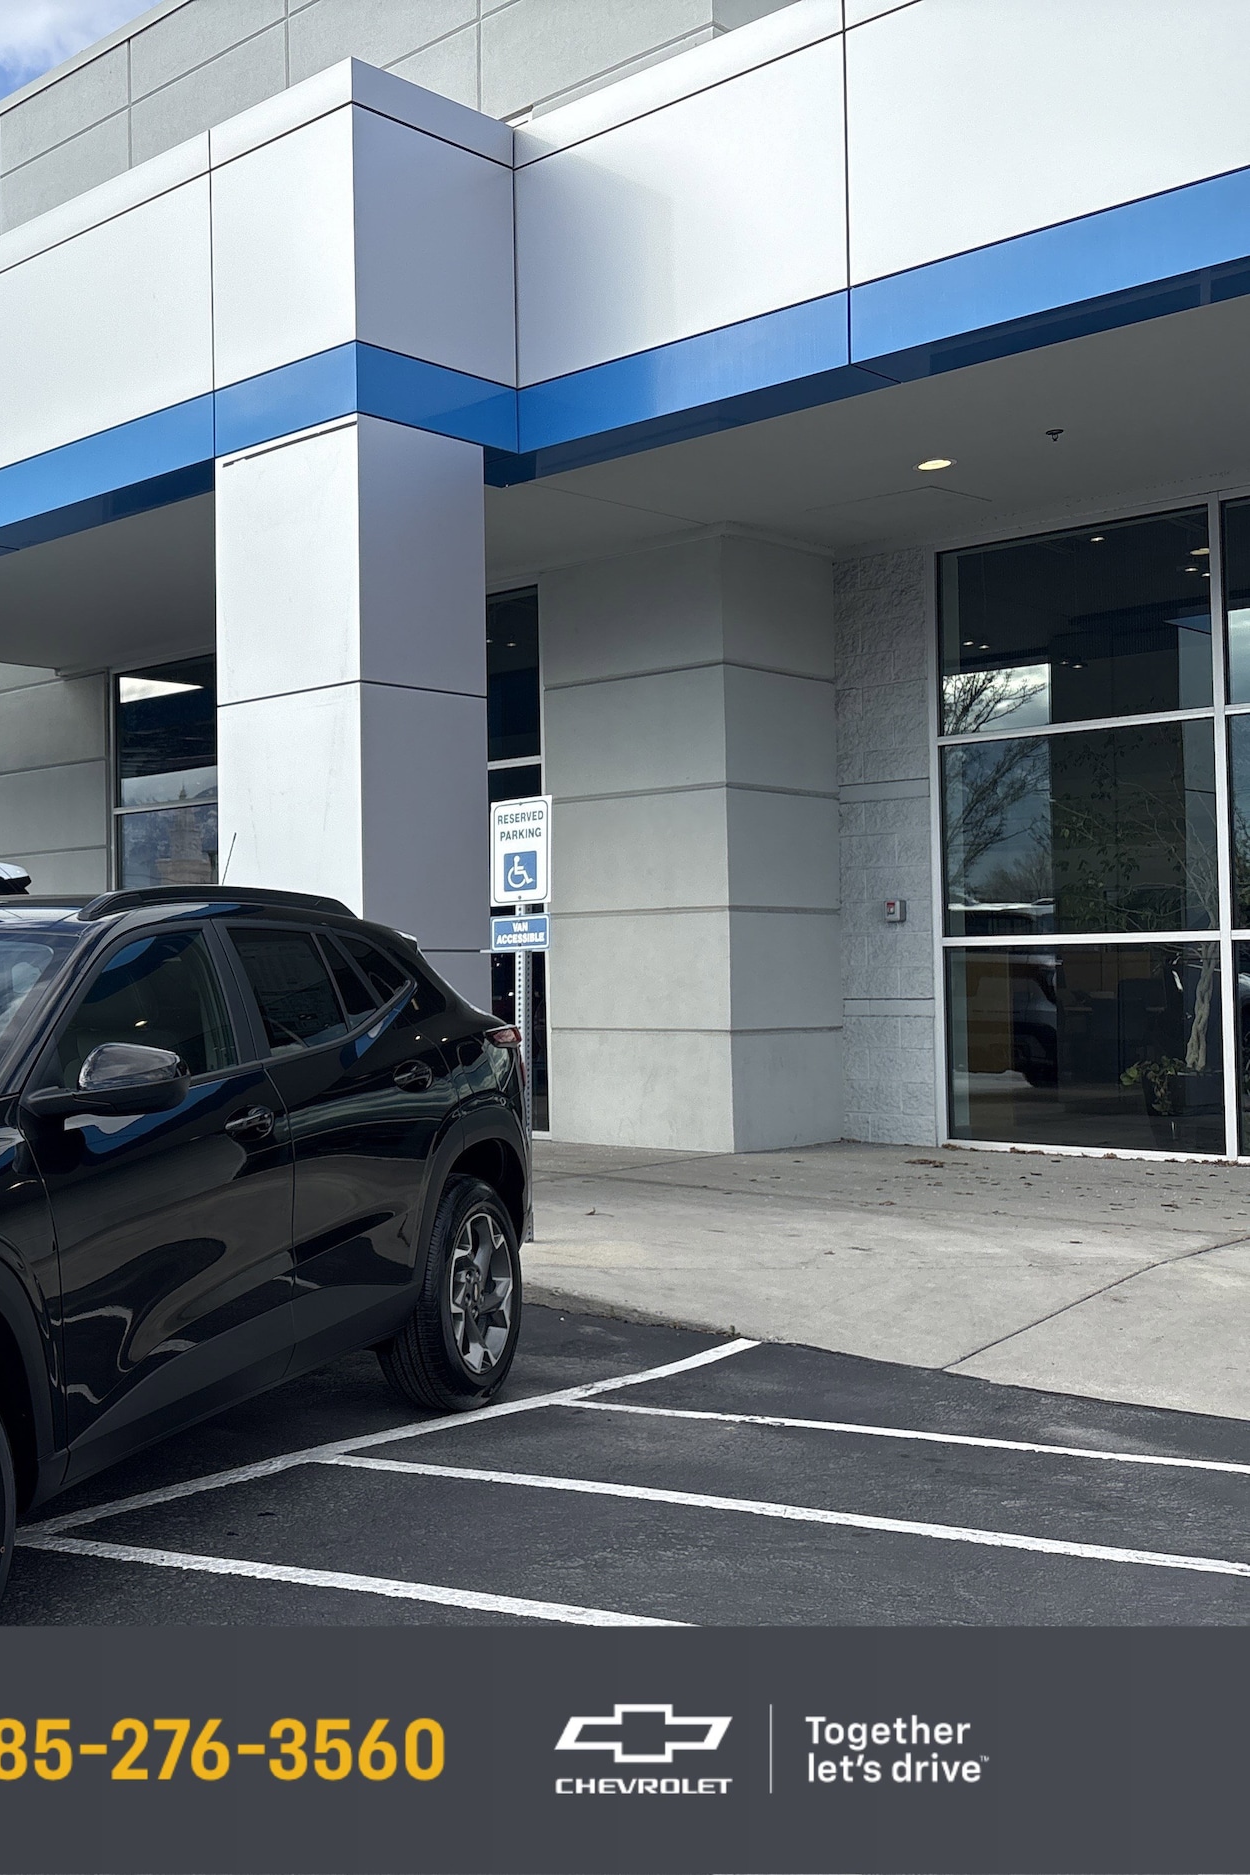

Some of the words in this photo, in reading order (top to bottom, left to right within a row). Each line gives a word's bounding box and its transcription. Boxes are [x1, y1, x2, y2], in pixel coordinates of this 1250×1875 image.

[497, 810, 544, 825] RESERVED
[500, 827, 542, 841] PARKING
[512, 922, 528, 932] VAN
[496, 931, 545, 944] ACCESSIBLE
